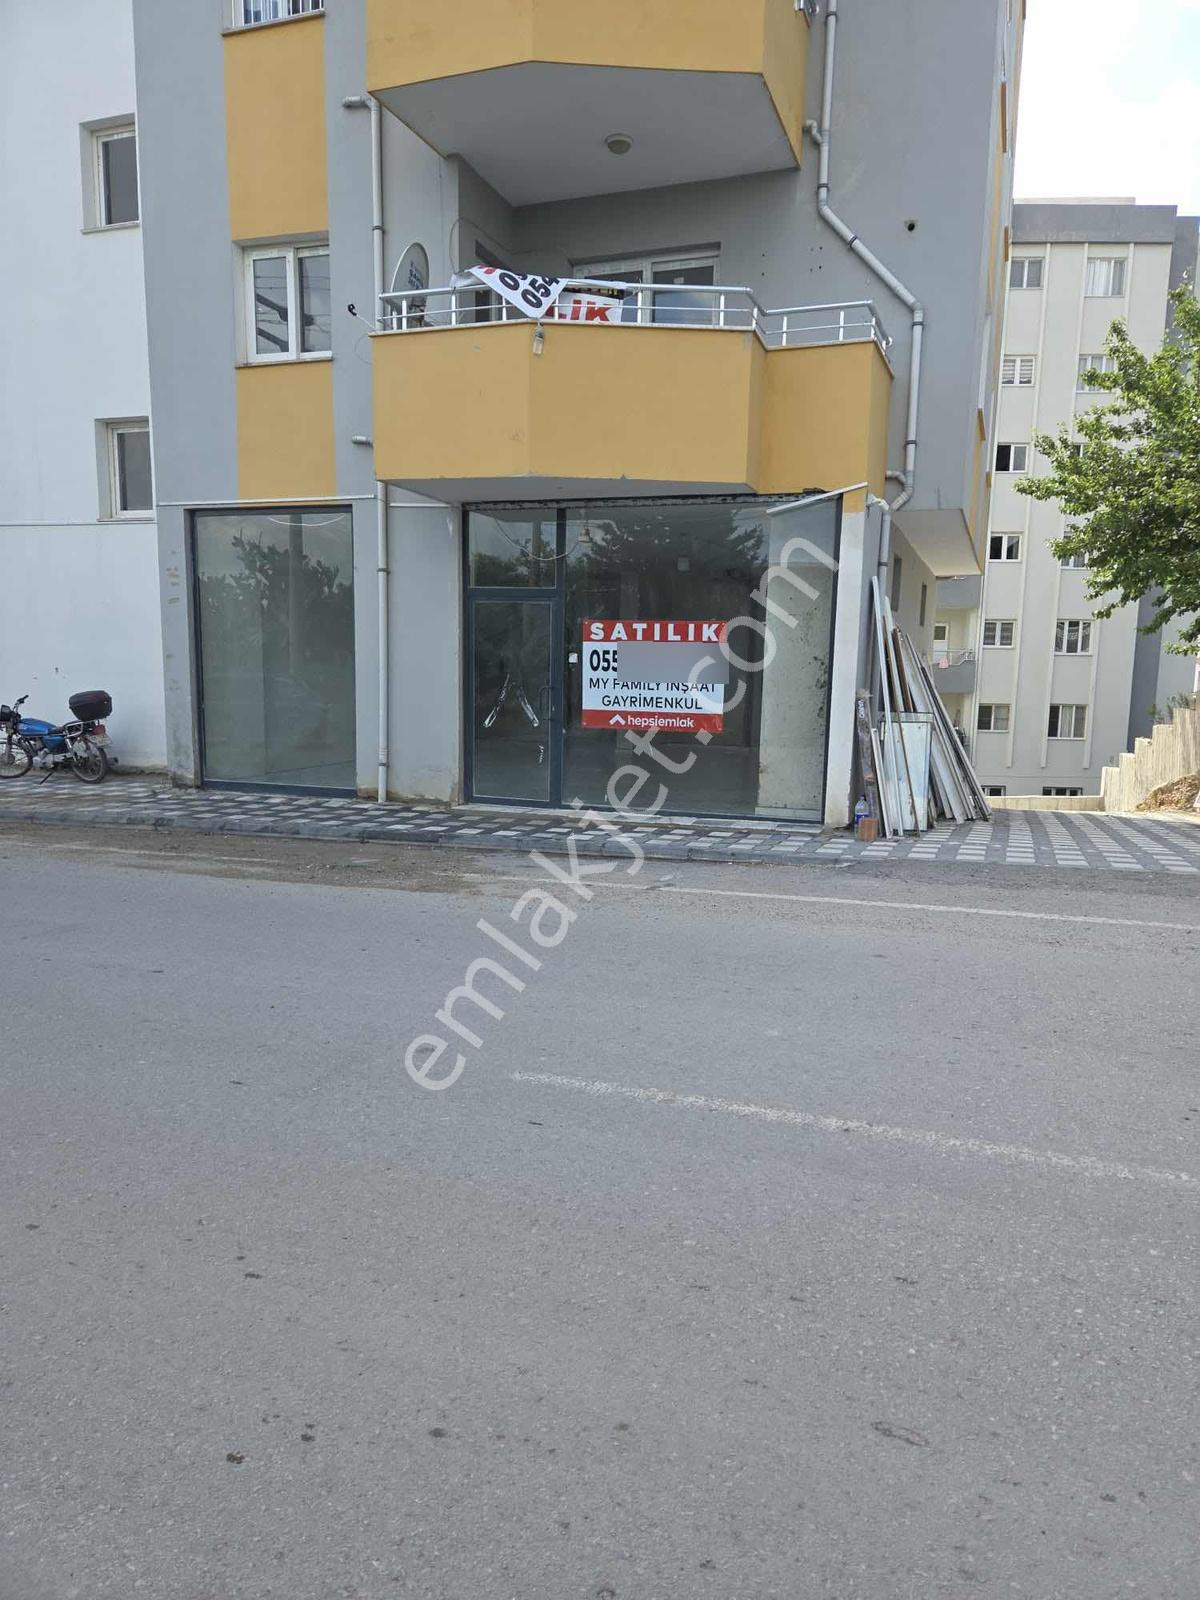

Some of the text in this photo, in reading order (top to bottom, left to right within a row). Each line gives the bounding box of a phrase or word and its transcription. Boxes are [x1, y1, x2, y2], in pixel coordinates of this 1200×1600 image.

[590, 622, 720, 642] SATILIK
[589, 677, 609, 689] MY
[613, 678, 660, 691] FAMILY
[602, 694, 703, 710] GAYRİMENKUL
[627, 715, 695, 728] hepsiemlak
